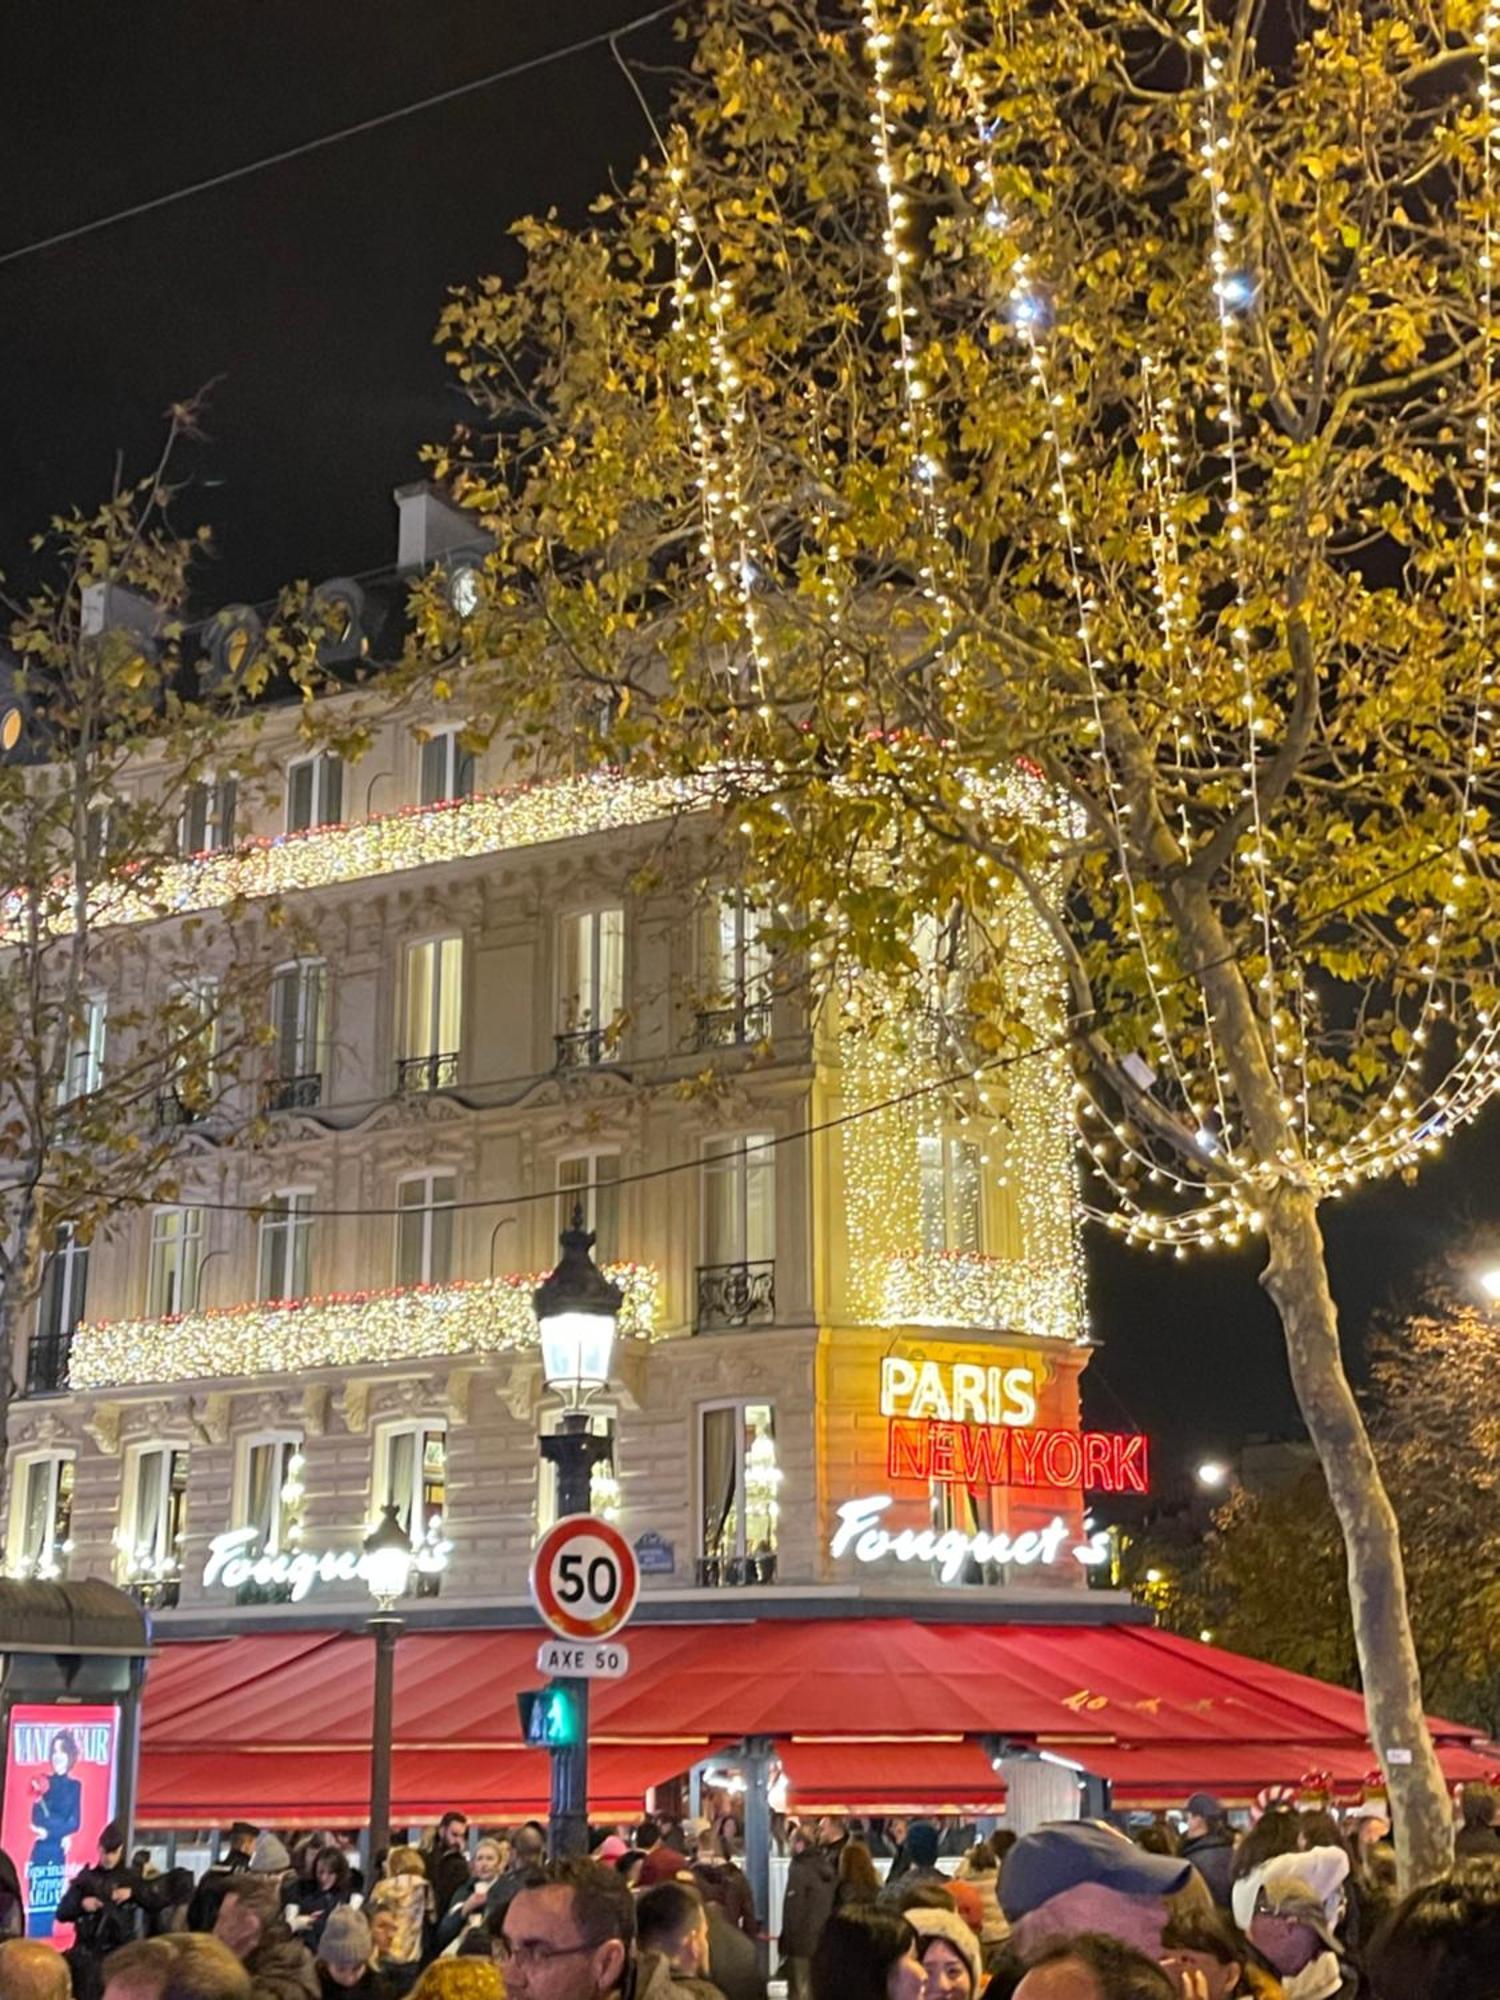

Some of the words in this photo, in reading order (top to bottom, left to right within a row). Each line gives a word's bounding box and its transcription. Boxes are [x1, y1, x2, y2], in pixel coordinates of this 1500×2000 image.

[879, 1357, 1037, 1426] PARIS
[889, 1418, 1007, 1485] NEW
[1011, 1430, 1147, 1492] YORK
[556, 1554, 617, 1604] 50
[548, 1651, 585, 1670] AXE
[595, 1652, 619, 1669] 50
